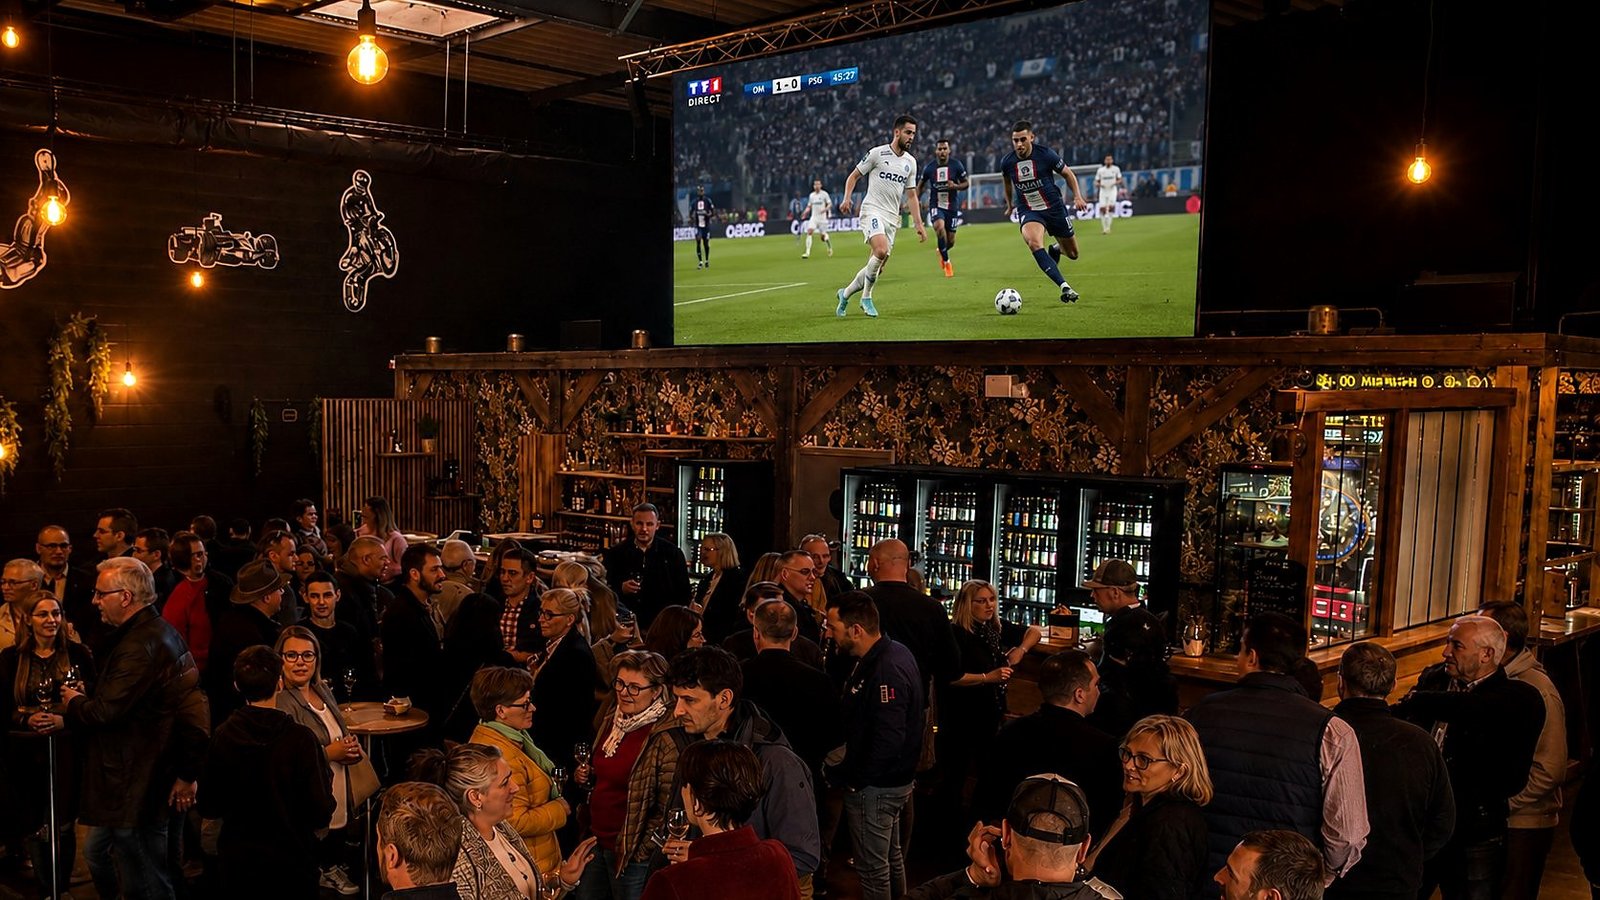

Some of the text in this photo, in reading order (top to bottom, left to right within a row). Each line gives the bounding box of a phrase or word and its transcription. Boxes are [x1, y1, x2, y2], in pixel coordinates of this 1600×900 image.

[689, 79, 719, 95] TF1
[752, 86, 765, 95] OM
[808, 76, 823, 86] PSG
[832, 71, 855, 82] 45:27
[688, 94, 721, 107] DIRECT
